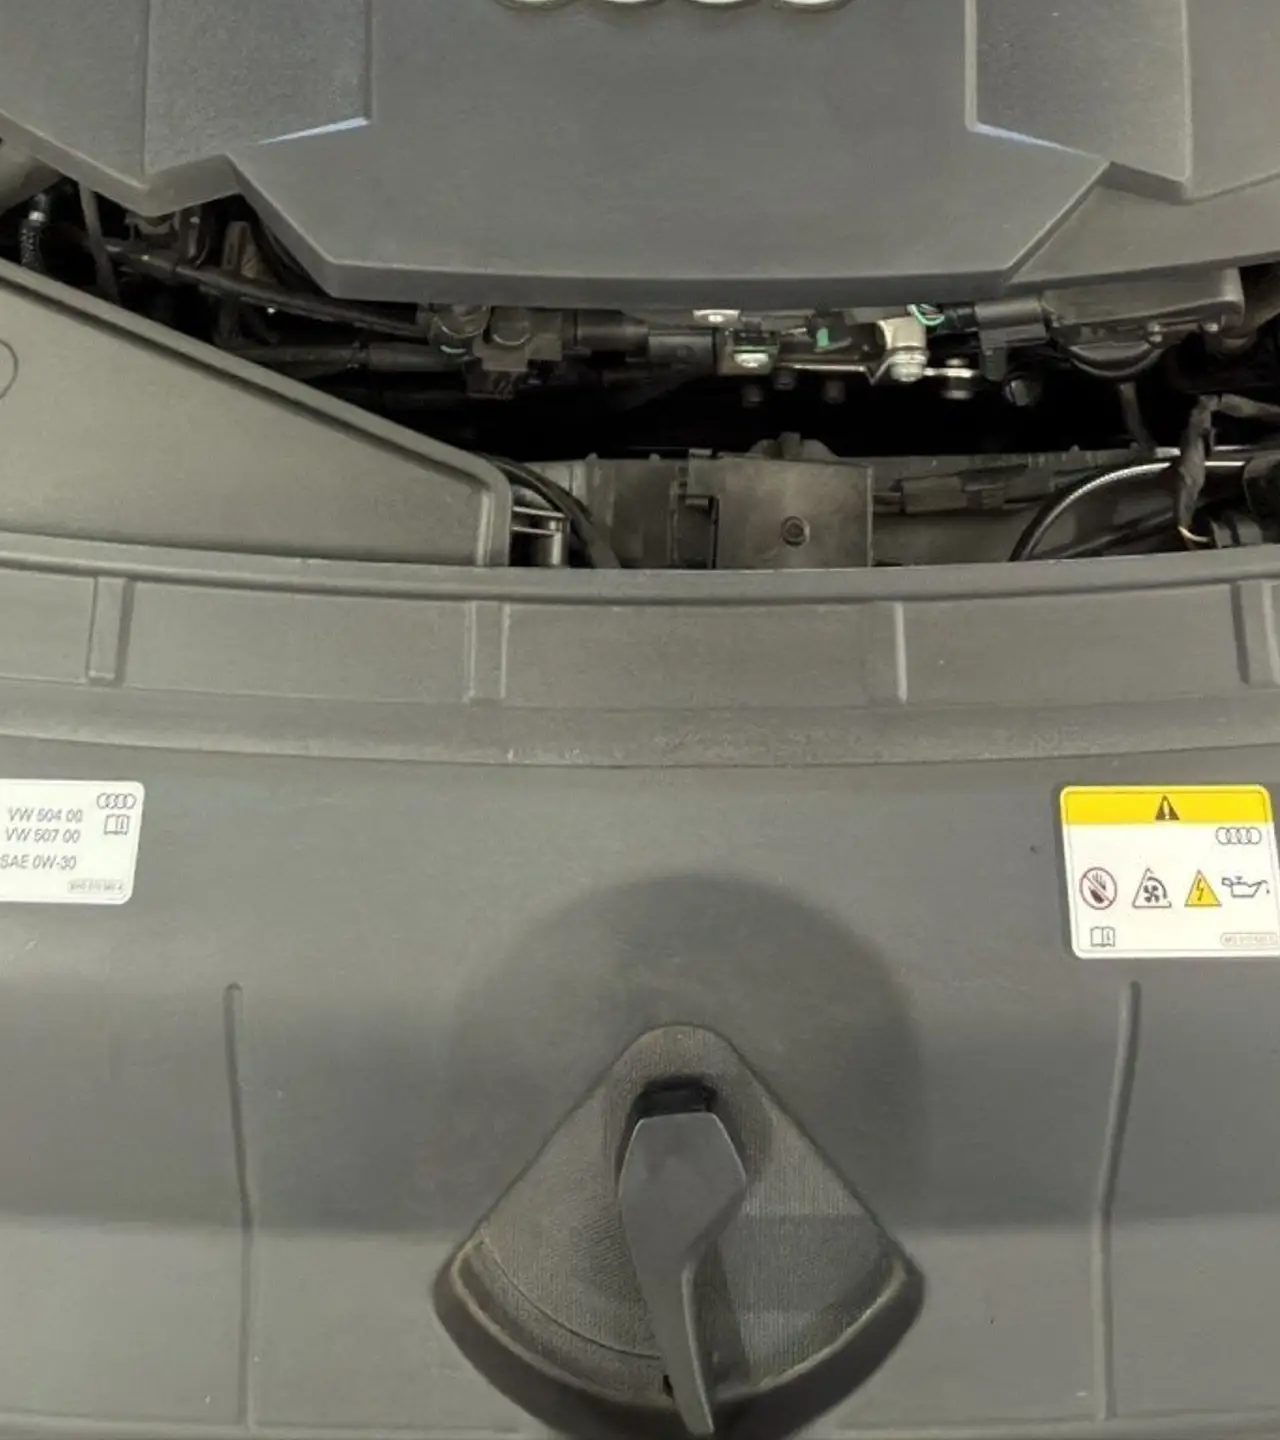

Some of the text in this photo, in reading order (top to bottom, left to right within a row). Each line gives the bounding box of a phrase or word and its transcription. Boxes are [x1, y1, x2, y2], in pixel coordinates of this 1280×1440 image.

[7, 808, 83, 823] VW 504 00
[5, 827, 81, 843] VW 507 00
[32, 854, 77, 870] 0W-30
